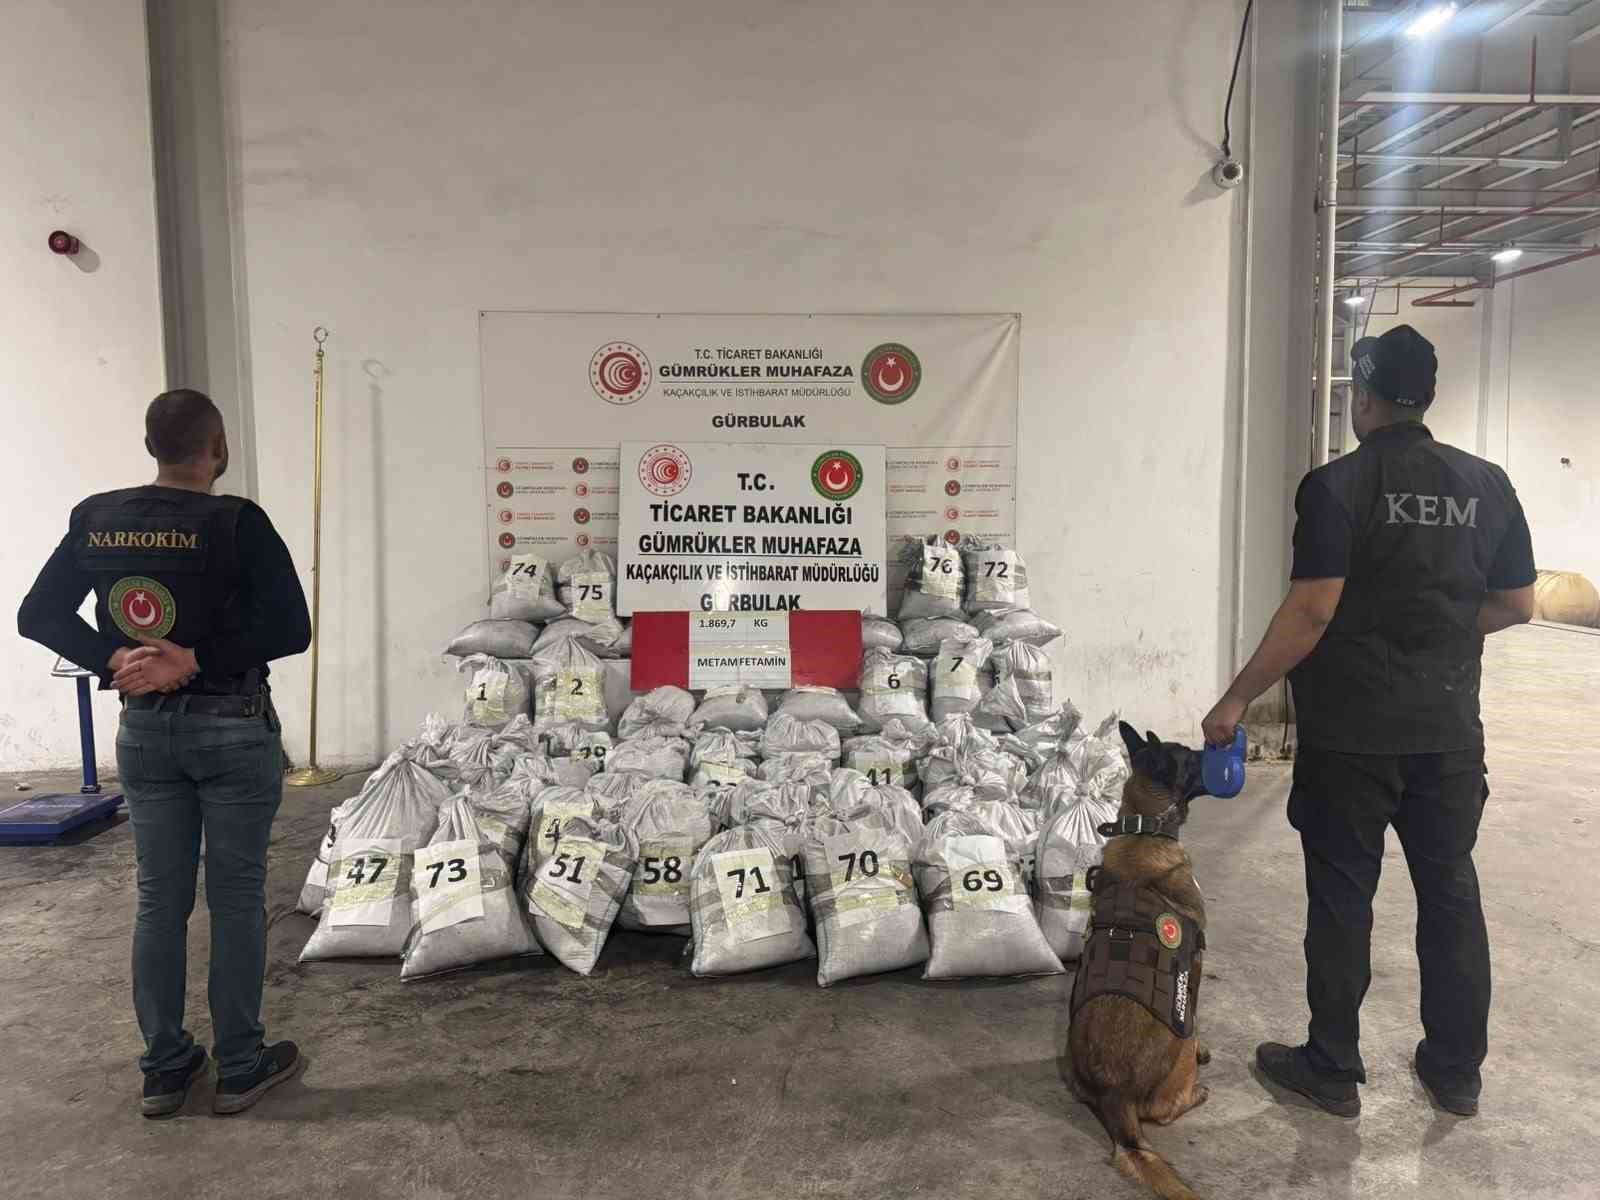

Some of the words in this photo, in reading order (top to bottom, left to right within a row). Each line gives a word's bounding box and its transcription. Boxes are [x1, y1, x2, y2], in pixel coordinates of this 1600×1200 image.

[695, 349, 713, 360] T.C.
[717, 346, 761, 360] TİCARET
[764, 346, 823, 360] BAKANLIĞI
[659, 363, 761, 378] GÜMRÜKLER
[766, 365, 854, 378] MUHAFAZA
[663, 388, 718, 399] KAÇAKÇILIK
[720, 388, 732, 398] VE
[735, 387, 789, 398] İSTİHBARAT
[791, 386, 850, 397] MÜDÜRLÜĞÜ
[712, 412, 806, 428] GÜRBULAK
[737, 472, 775, 491] T.C.
[649, 500, 737, 523] TİCARET
[743, 502, 853, 525] BAKANLIĞI
[1384, 493, 1480, 528] KEM
[87, 528, 201, 549] NARKOKİM
[639, 531, 757, 554] GÜMRÜKLER
[761, 536, 863, 556] MUHAFAZA
[511, 562, 537, 578] 74
[626, 563, 703, 584] KAÇAKÇILIK
[706, 564, 723, 581] VE
[726, 561, 799, 582] İSTİHBARAT
[802, 563, 879, 583] MÜDÜRLÜĞÜ
[929, 556, 953, 574] 76
[984, 561, 1009, 578] 72
[578, 584, 603, 601] 75
[699, 618, 736, 629] 1.869,7
[753, 618, 768, 628] KG
[697, 655, 787, 668] METAMFETAMİN
[950, 656, 964, 673] 7
[571, 678, 584, 696] 2
[887, 673, 901, 690] 6
[476, 682, 488, 701] 1
[346, 857, 389, 885] 47
[425, 858, 468, 889] 73
[549, 852, 586, 884] 51
[642, 855, 683, 885] 58
[838, 849, 880, 882] 70
[727, 865, 771, 899] 71
[962, 869, 1004, 892] 69
